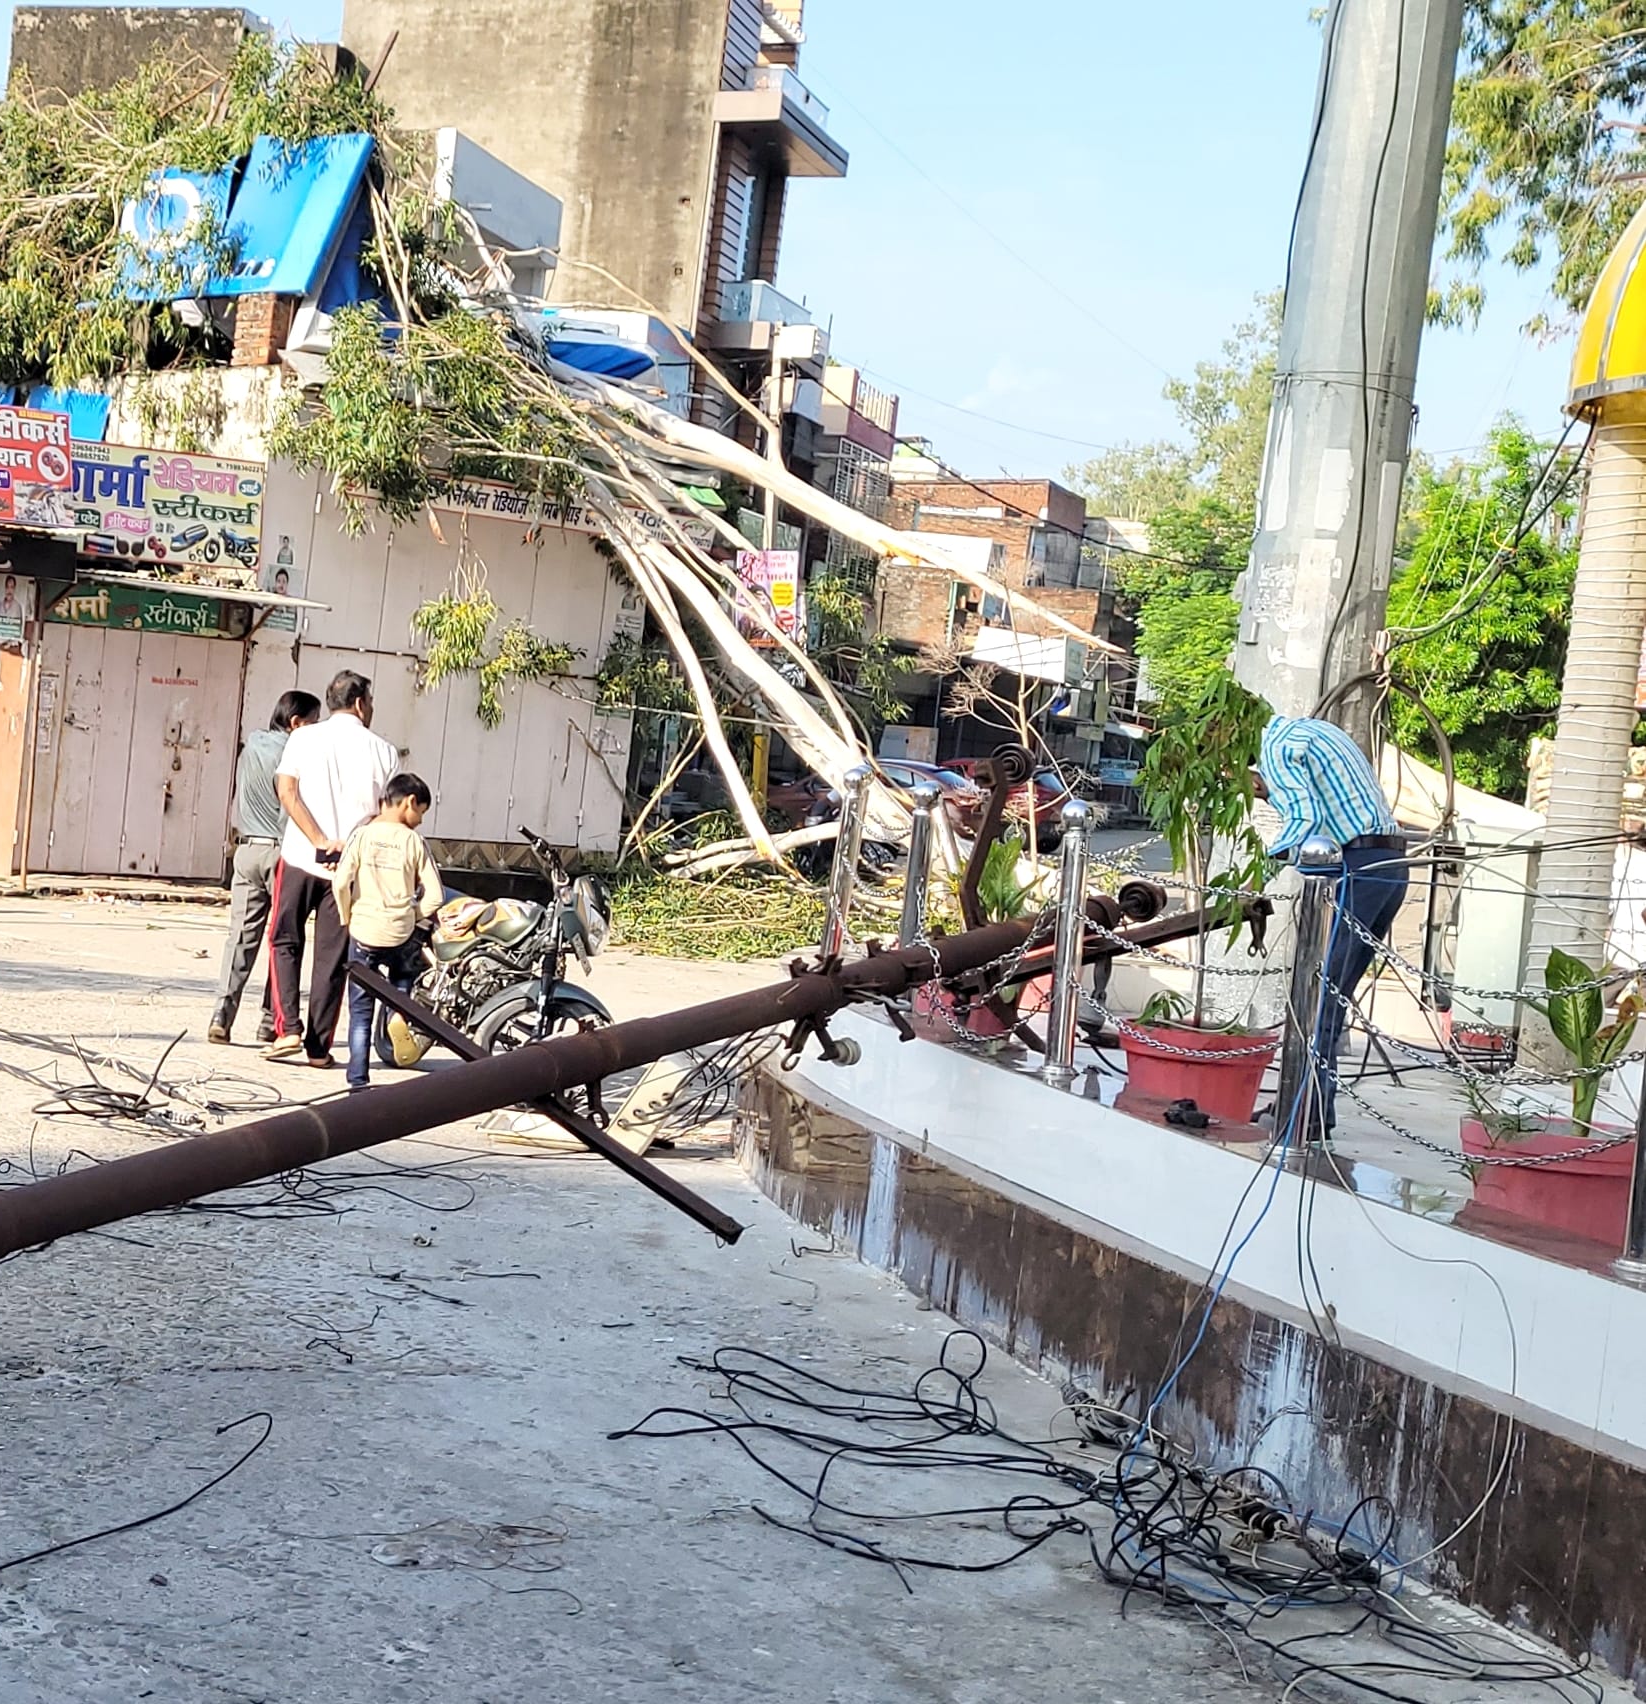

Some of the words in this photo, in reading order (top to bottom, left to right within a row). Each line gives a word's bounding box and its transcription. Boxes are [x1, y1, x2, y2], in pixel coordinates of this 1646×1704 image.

[154, 456, 238, 497] रेडियम
[152, 494, 259, 525] स्टीकर्स
[54, 588, 111, 620] शर्मा
[144, 598, 208, 631] स्टीकर्स
